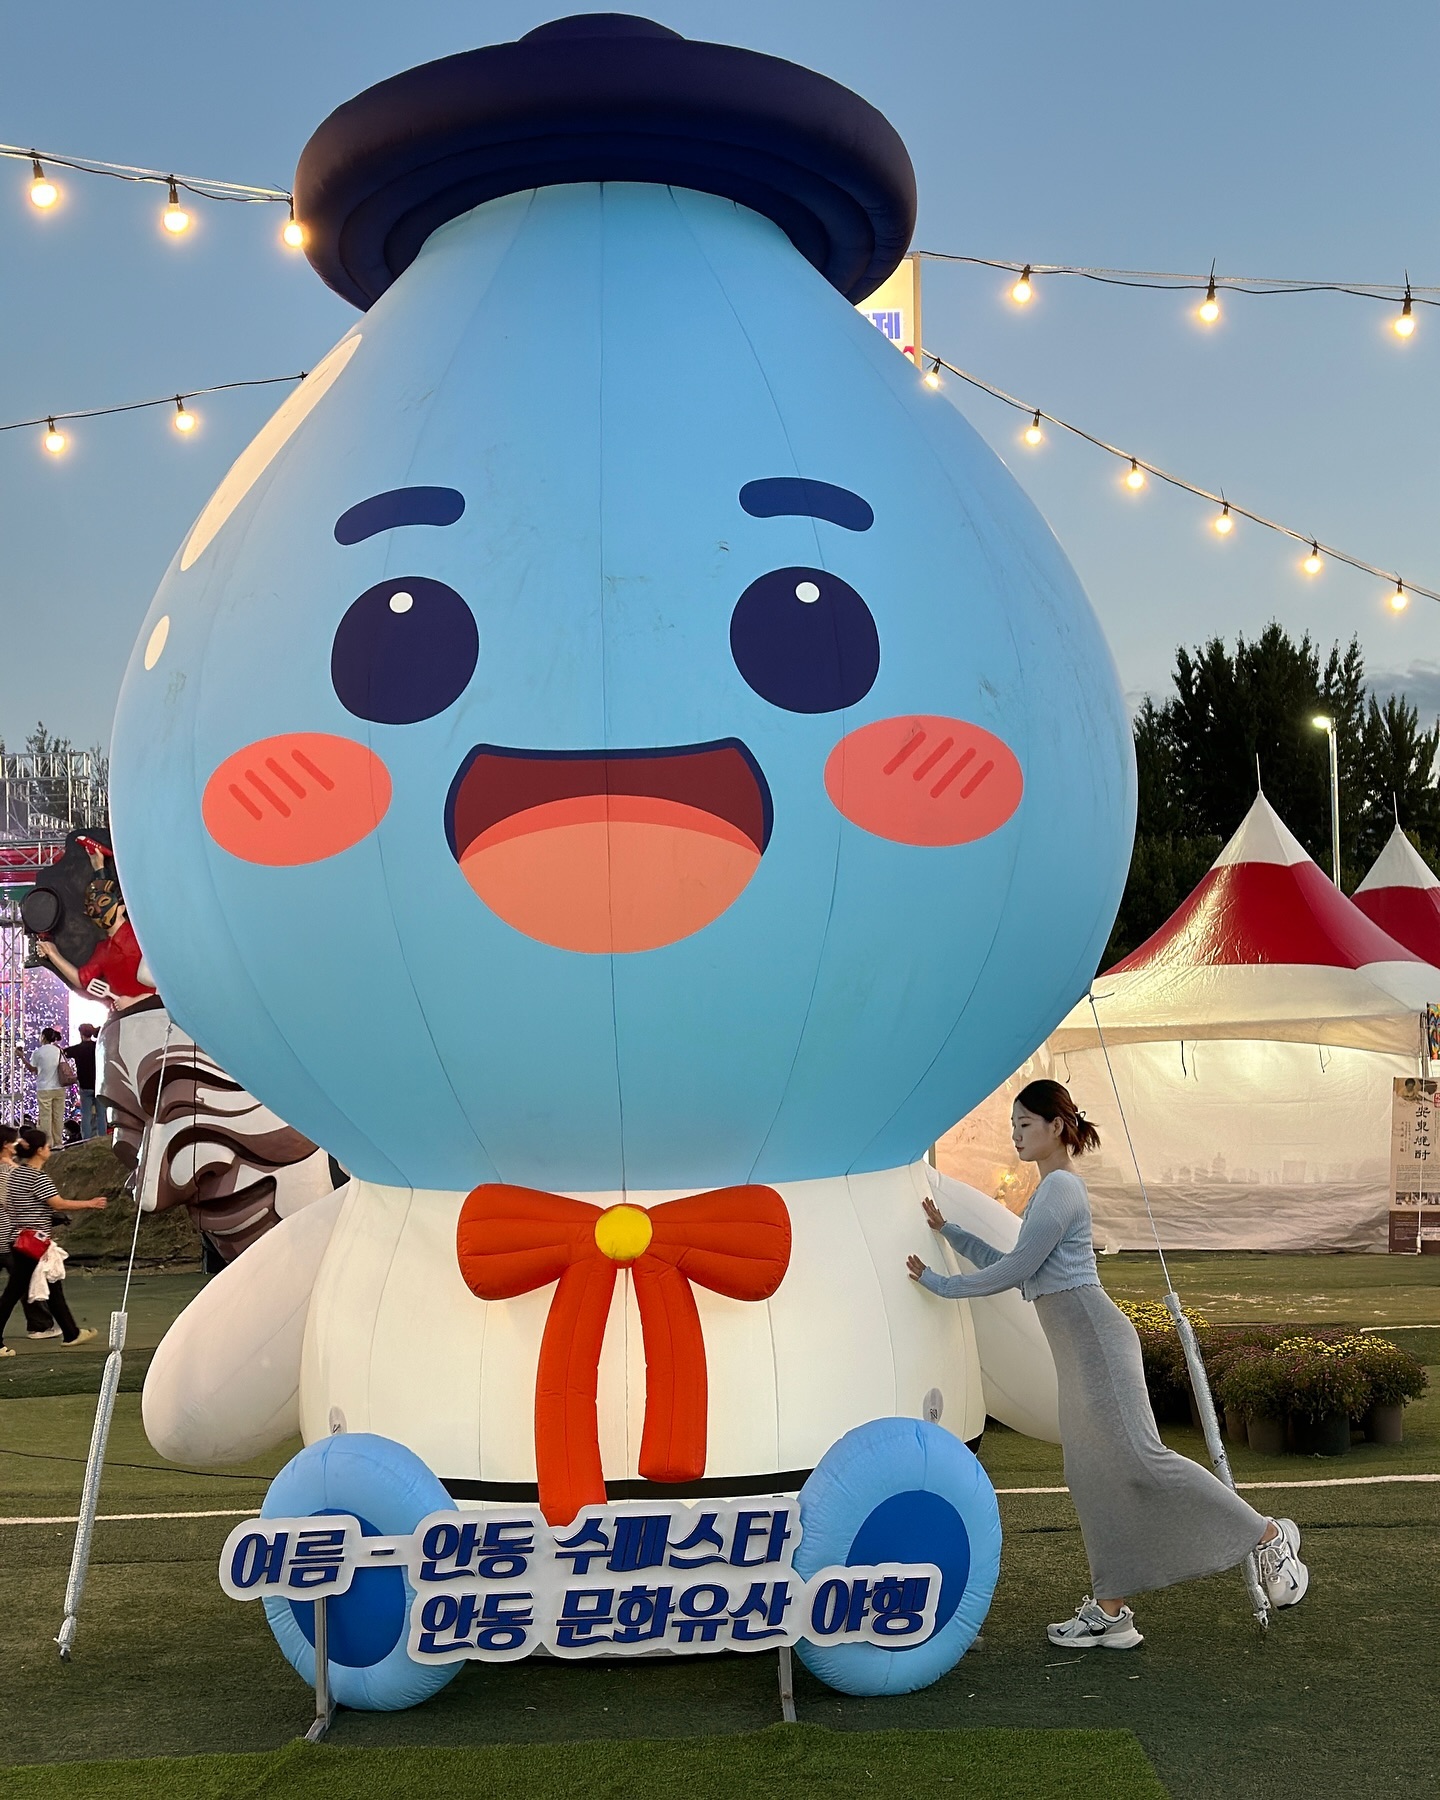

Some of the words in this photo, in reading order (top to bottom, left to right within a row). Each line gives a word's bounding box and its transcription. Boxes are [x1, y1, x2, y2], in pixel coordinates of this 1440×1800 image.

[231, 1529, 347, 1588] 여름
[419, 1520, 535, 1582] 안동
[418, 1591, 534, 1654] 안동
[555, 1581, 792, 1648] 문화유산
[811, 1576, 932, 1635] 야행
